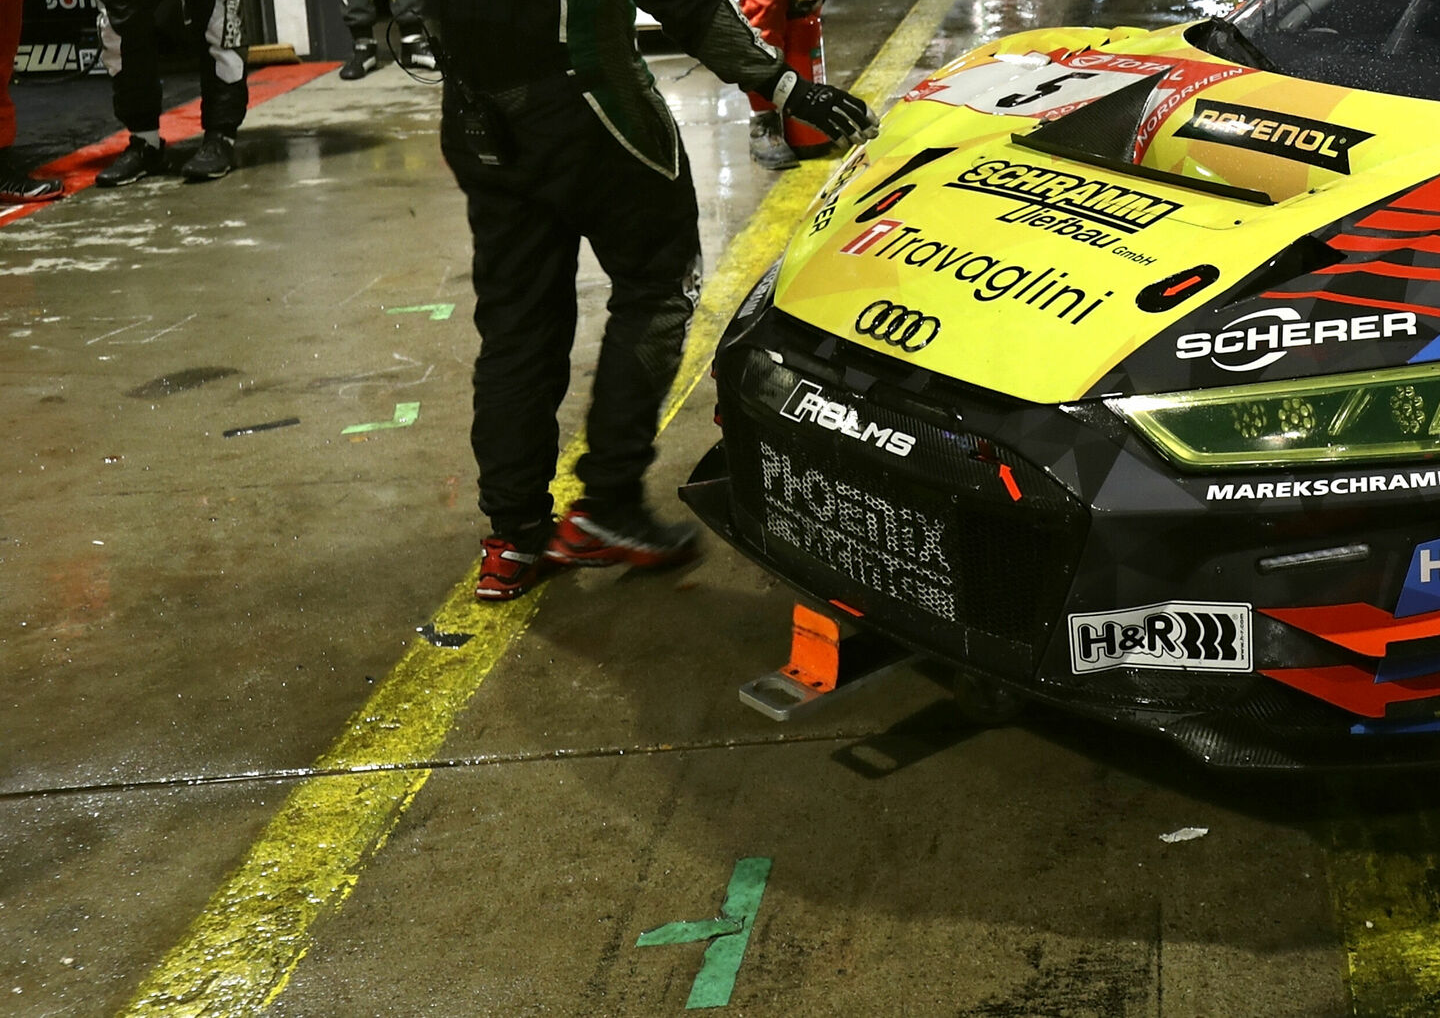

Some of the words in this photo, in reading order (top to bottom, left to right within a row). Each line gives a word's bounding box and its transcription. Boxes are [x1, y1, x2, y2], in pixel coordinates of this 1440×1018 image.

[995, 72, 1100, 109] 5
[1043, 99, 1088, 120] ADA
[1137, 67, 1245, 145] NORDRHEIN
[957, 160, 1184, 229] SCHRAMM
[875, 226, 1115, 326] Travaglini
[1111, 245, 1158, 268] GmbH
[1175, 311, 1418, 362] SCHERER
[1079, 611, 1183, 662] H&R
